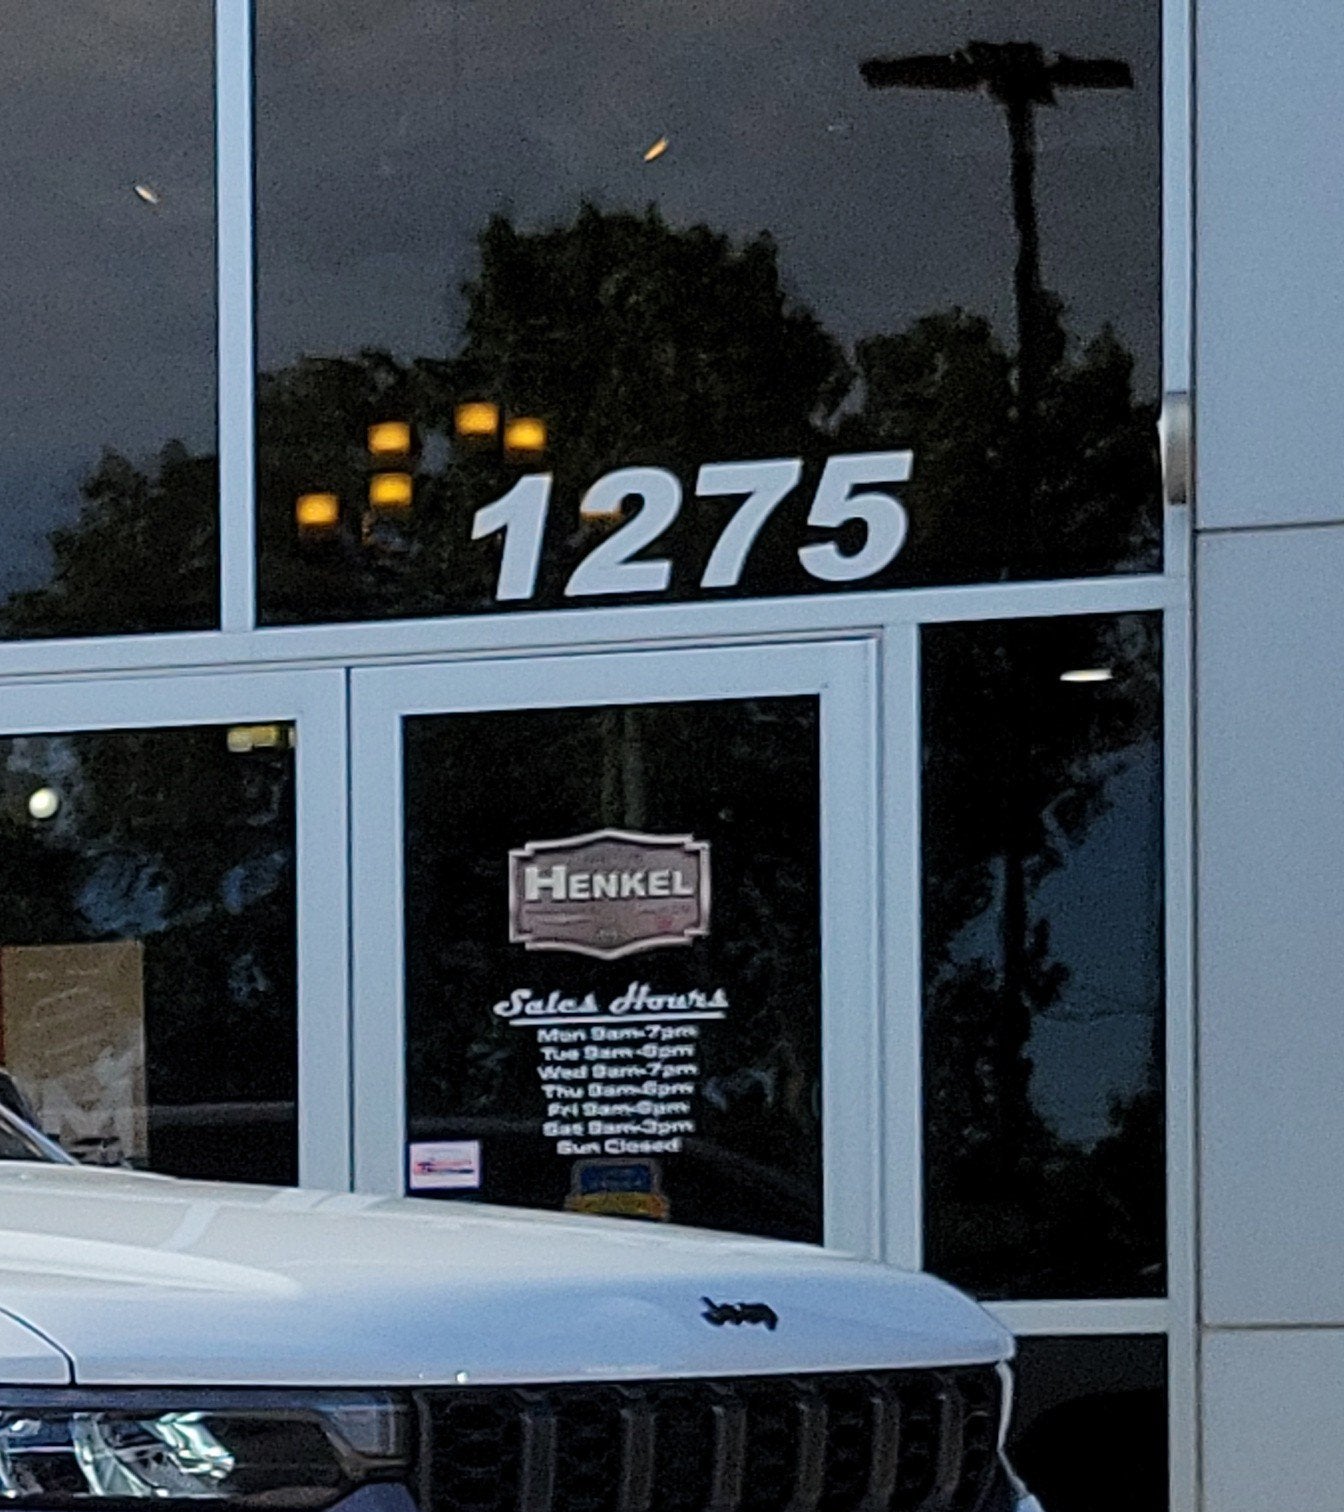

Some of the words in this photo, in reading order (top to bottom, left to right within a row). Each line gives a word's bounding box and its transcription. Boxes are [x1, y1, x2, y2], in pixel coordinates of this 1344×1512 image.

[470, 449, 913, 601] 1275
[524, 865, 695, 901] HENKEL
[493, 987, 599, 1017] Sales
[609, 980, 729, 1014] Hours
[537, 1028, 587, 1043] Mon
[540, 1046, 580, 1061] Tue
[537, 1064, 588, 1080] Wed
[541, 1084, 584, 1099] Thu
[547, 1102, 579, 1117] Fri
[542, 1121, 584, 1136] Sat
[557, 1140, 601, 1154] Sun
[604, 1136, 683, 1154] Closed
